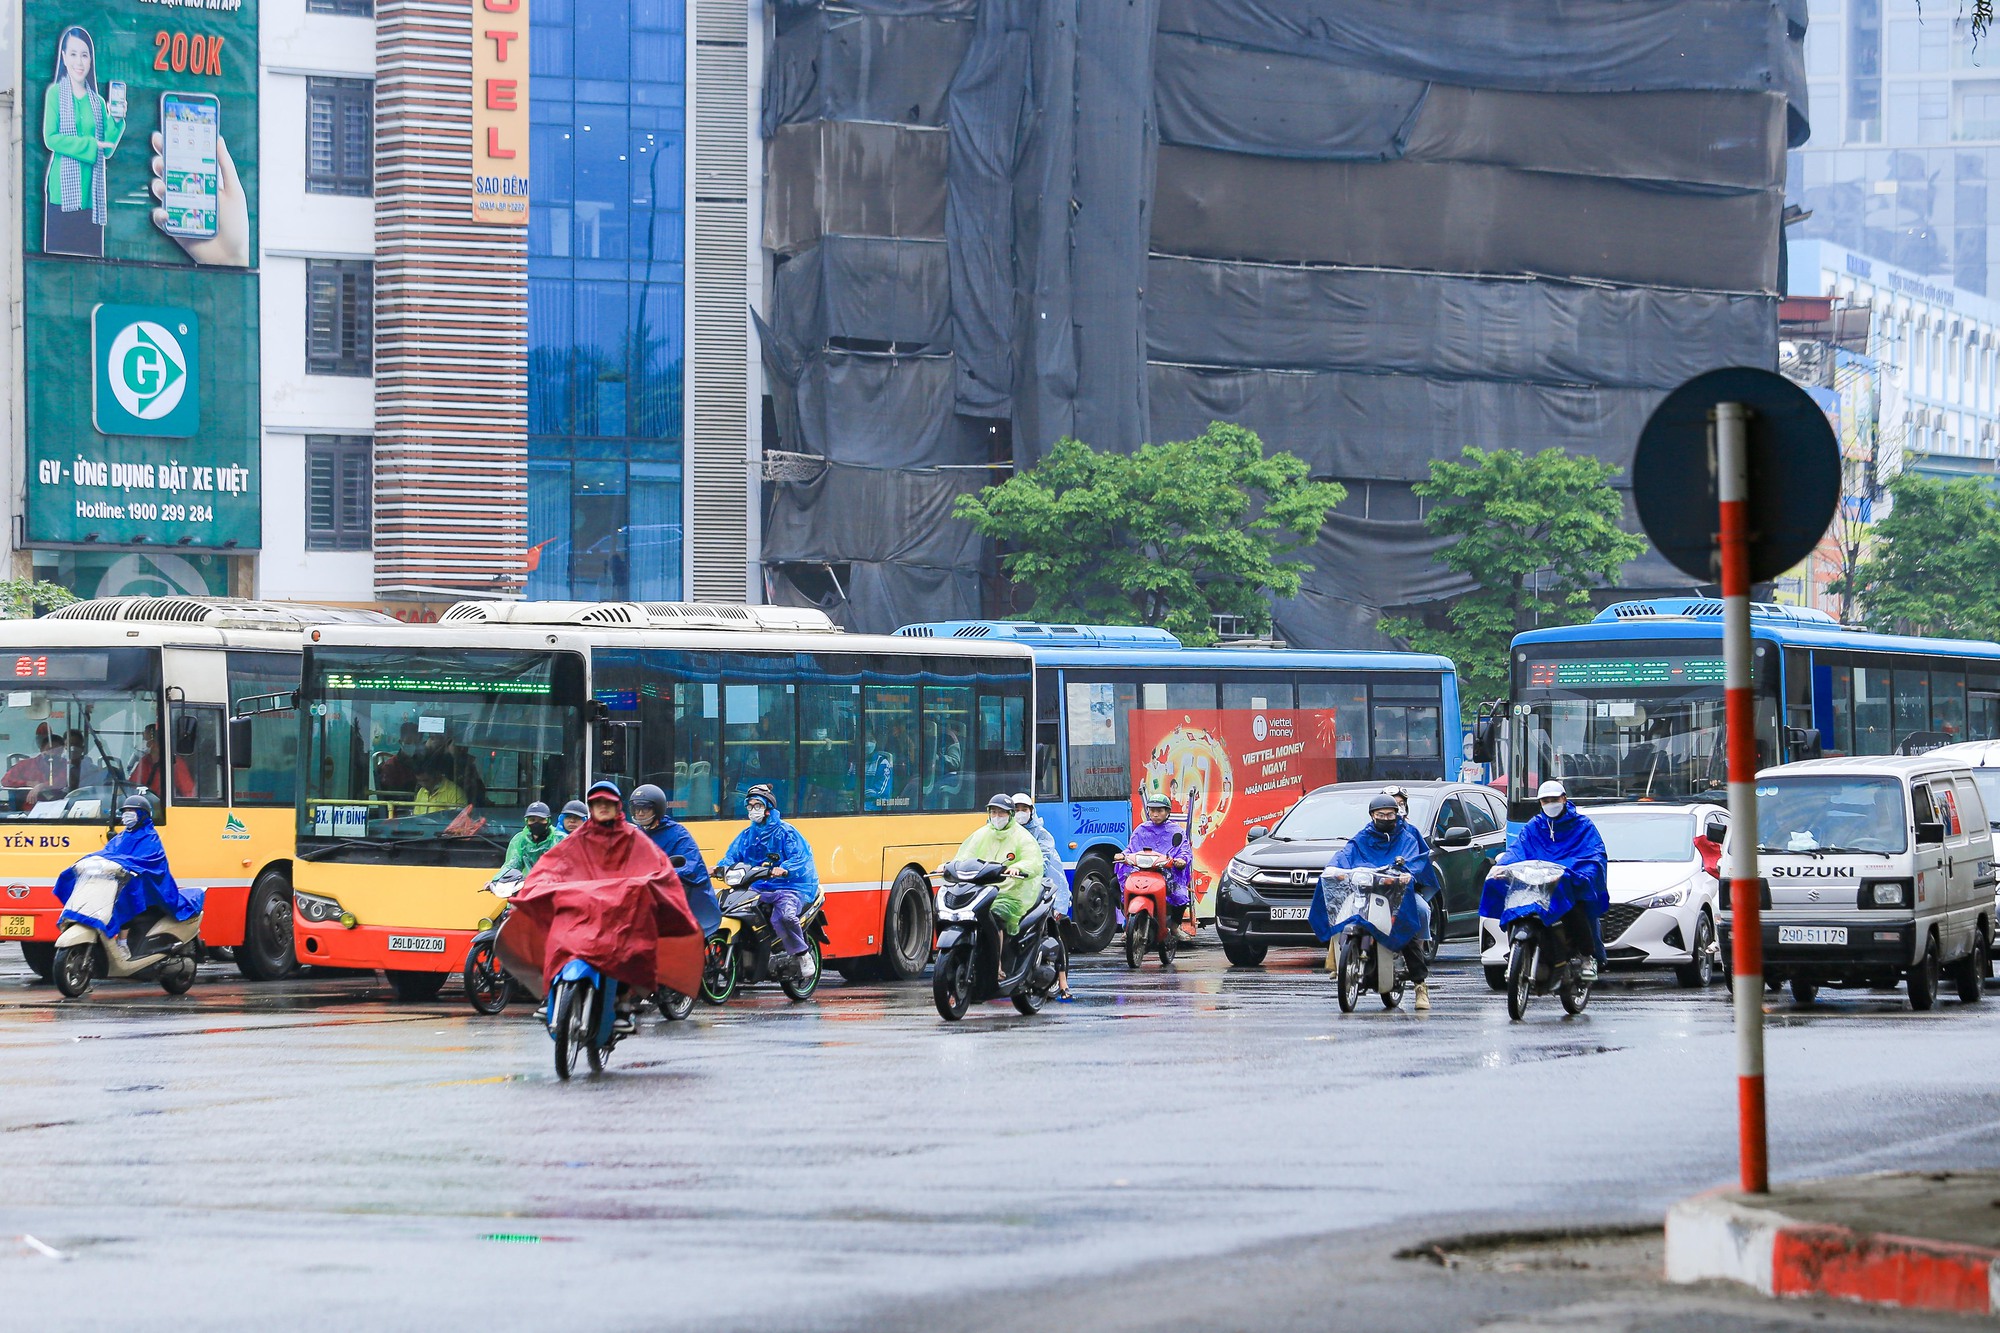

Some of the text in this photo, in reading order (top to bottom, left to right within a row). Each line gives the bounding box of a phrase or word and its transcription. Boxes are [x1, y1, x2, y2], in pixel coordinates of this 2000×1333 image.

[153, 31, 224, 76] 200K
[476, 175, 528, 196] SAO ĐÊM
[39, 459, 61, 485] GV
[73, 454, 108, 487] ỨNG
[111, 463, 155, 492] DỤNG
[158, 460, 188, 495] ĐẶT
[192, 466, 213, 491] XE
[216, 462, 249, 497] VIỆT
[76, 500, 213, 522] Hotline: 1900 299 284
[1269, 718, 1293, 727] viettel
[1269, 728, 1294, 738] money
[1242, 742, 1305, 766] VIETTEL MONEY
[1262, 760, 1287, 777] NGAY!
[1244, 782, 1262, 796] NHẬN
[1290, 775, 1303, 785] TAY
[1074, 819, 1126, 834] HANOIBUS
[4, 831, 70, 848] YẾN BUS
[1772, 866, 1855, 878] SUZUKI
